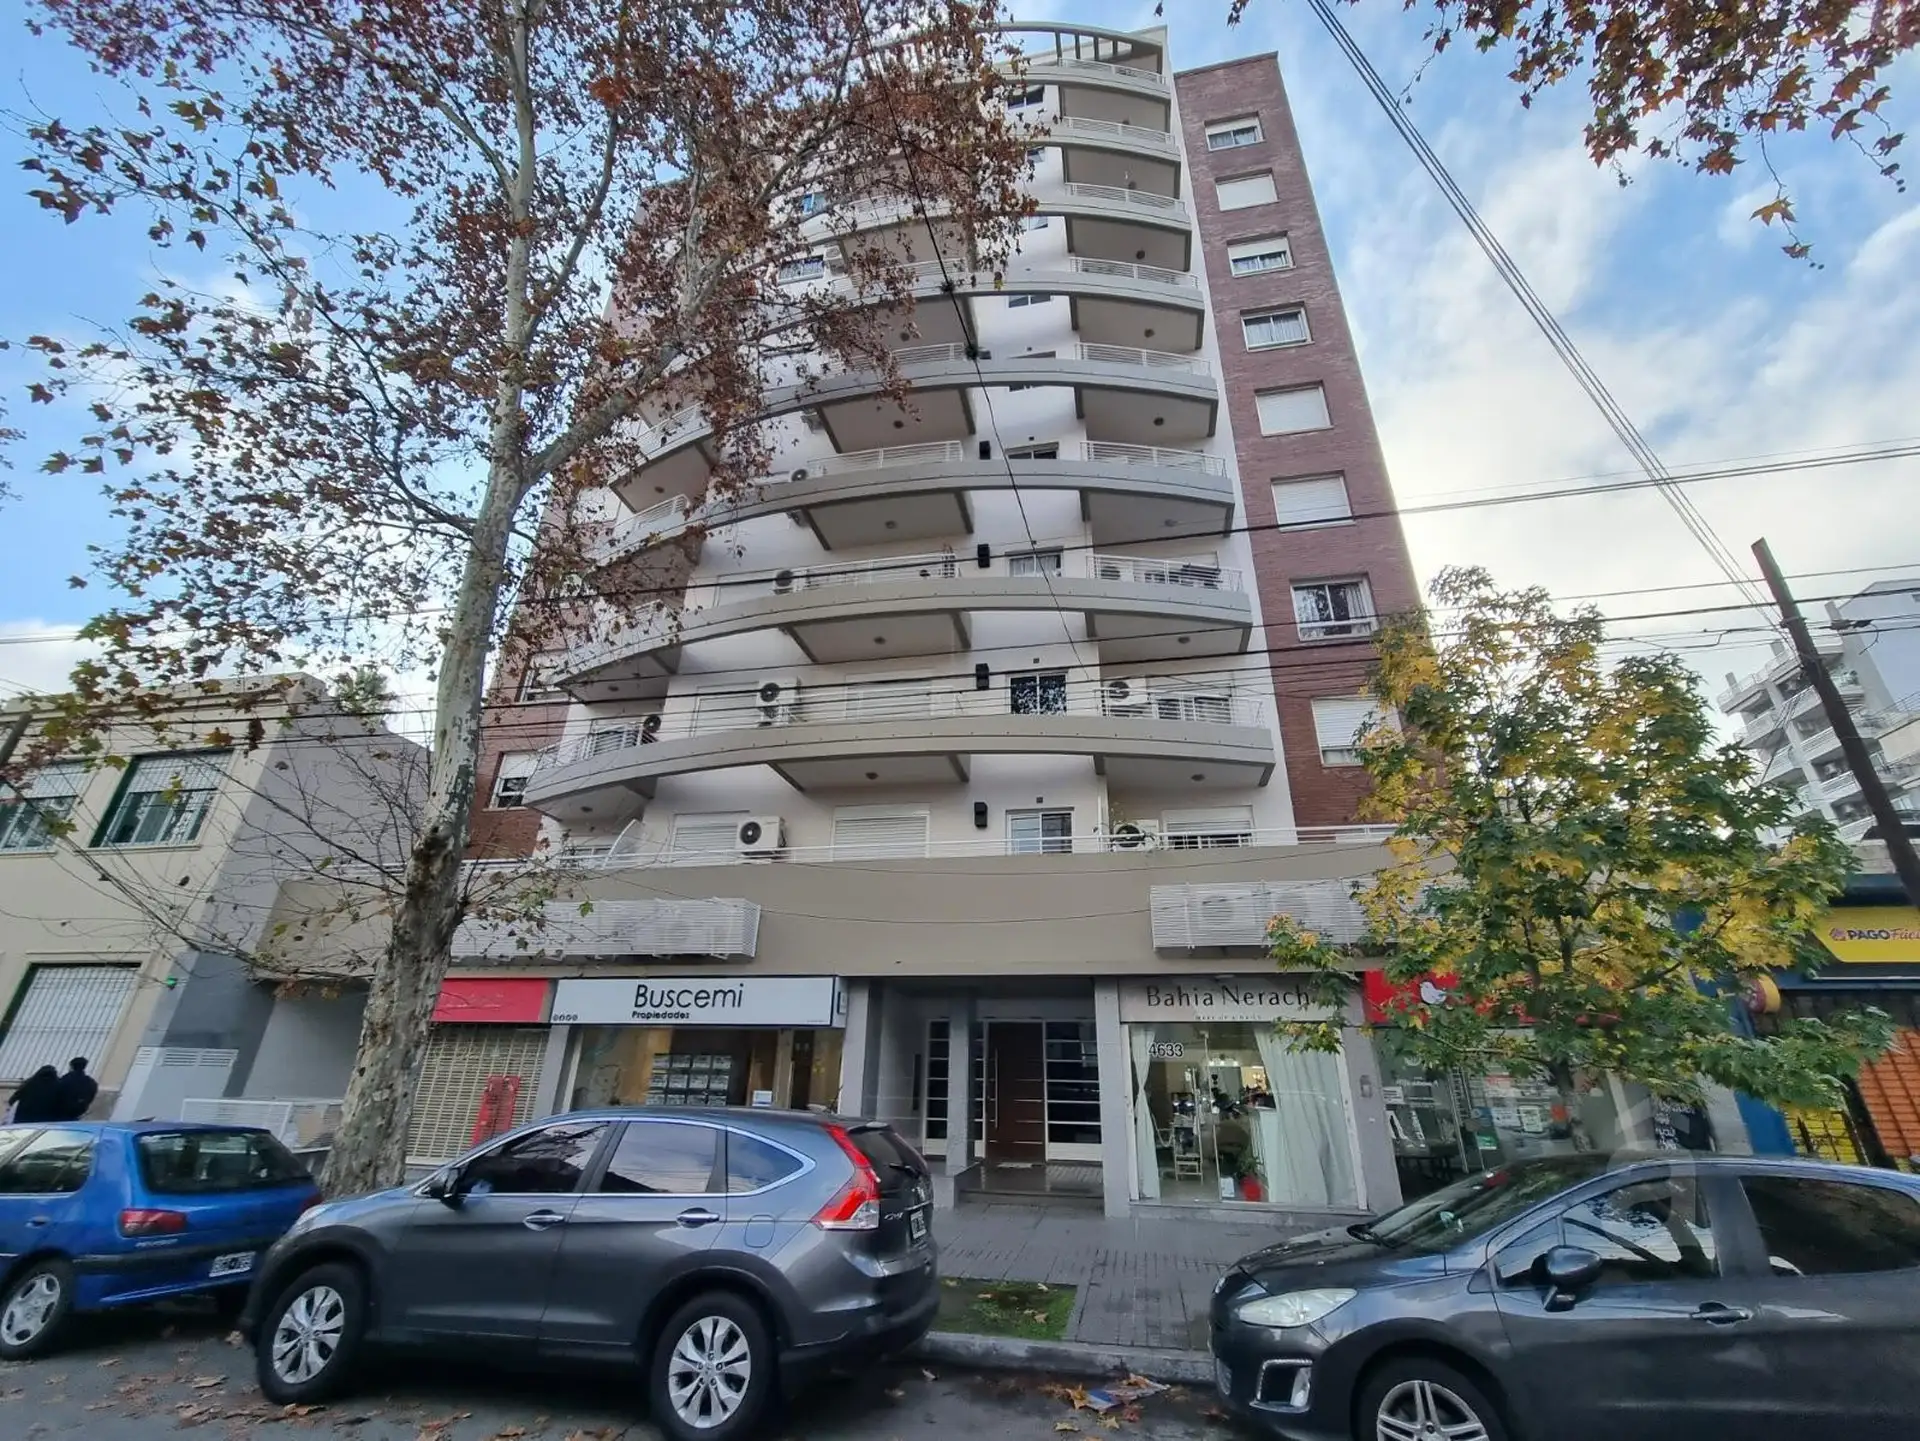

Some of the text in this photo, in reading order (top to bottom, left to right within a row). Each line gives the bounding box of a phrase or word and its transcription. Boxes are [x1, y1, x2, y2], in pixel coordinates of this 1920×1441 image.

[634, 983, 744, 1009] Buscemi
[1146, 984, 1310, 1007] Bahia Nerach
[631, 1010, 690, 1020] Propiedades
[1148, 1042, 1185, 1058] 4633
